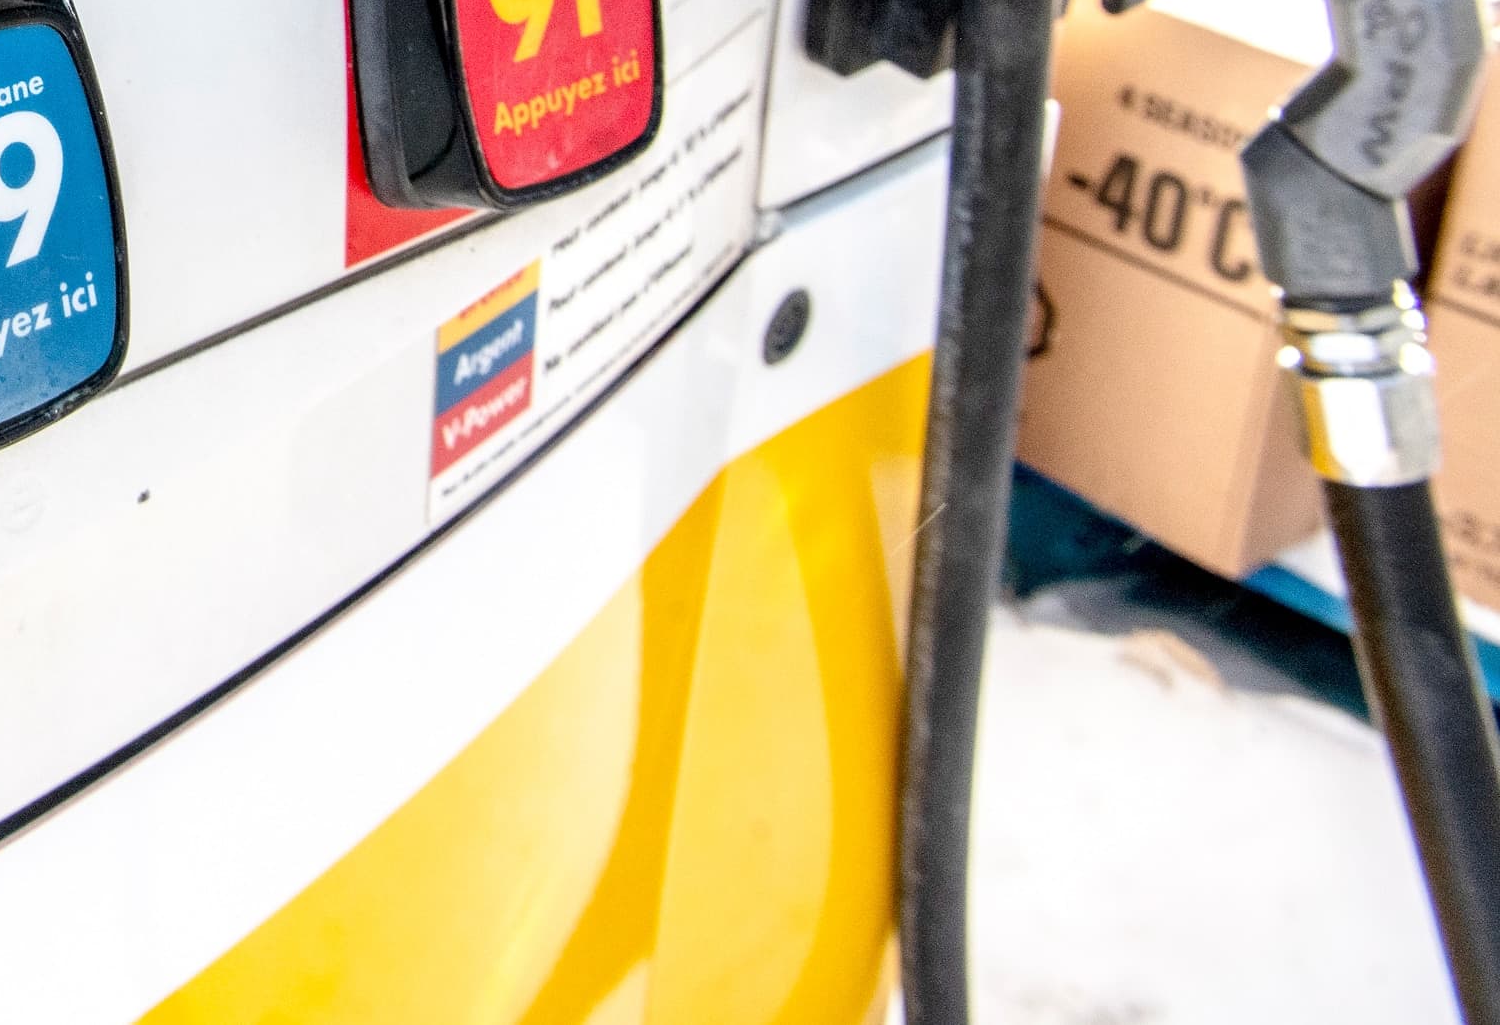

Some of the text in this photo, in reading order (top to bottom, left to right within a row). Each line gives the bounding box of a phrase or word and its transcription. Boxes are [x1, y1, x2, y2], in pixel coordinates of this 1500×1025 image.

[494, 49, 640, 136] Appuyez ici
[60, 272, 96, 317] ici
